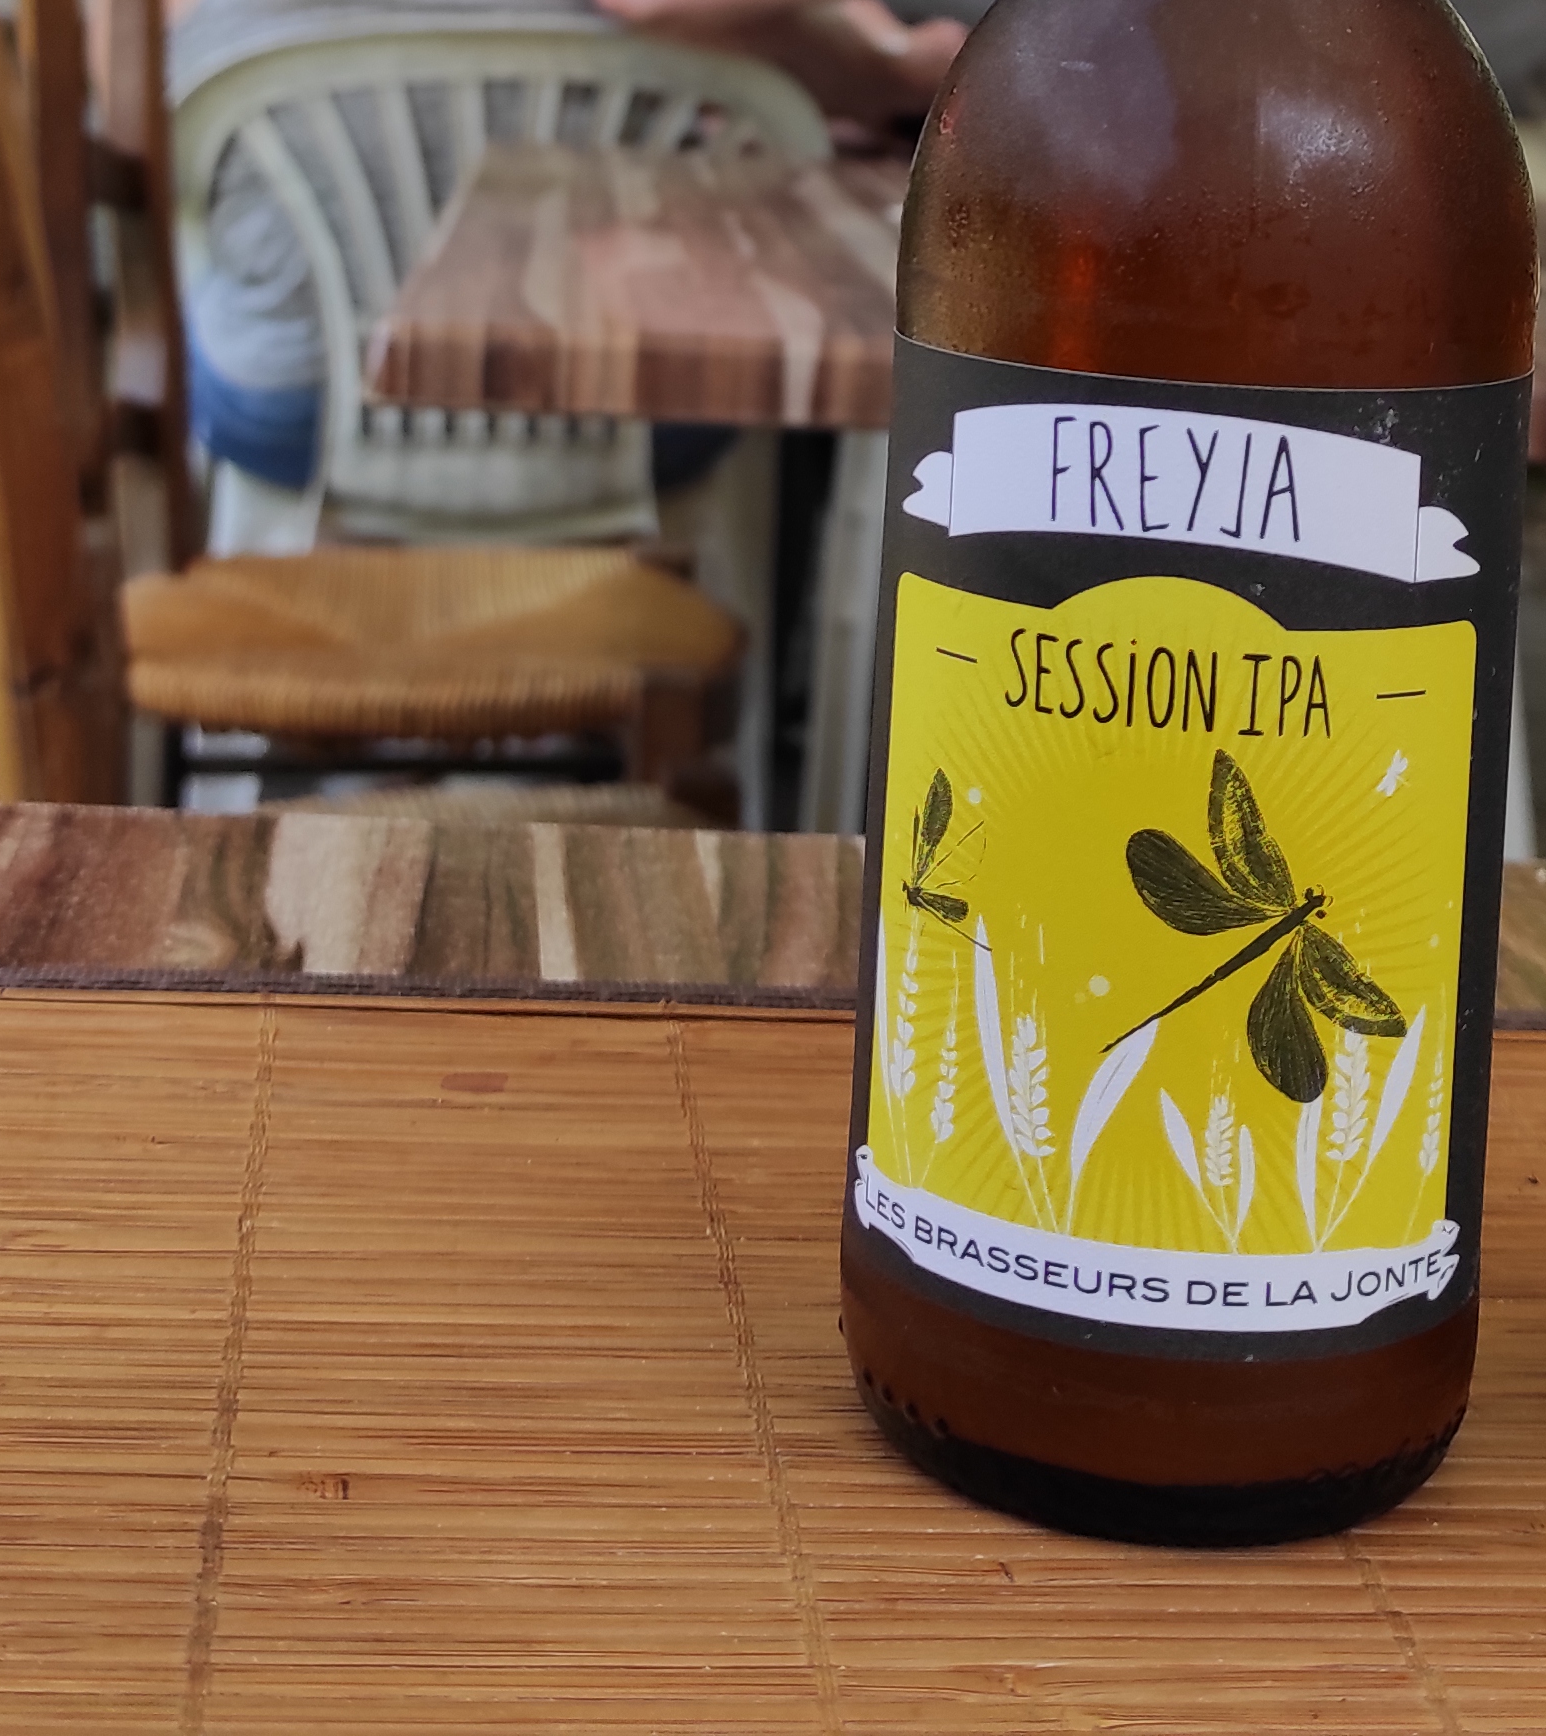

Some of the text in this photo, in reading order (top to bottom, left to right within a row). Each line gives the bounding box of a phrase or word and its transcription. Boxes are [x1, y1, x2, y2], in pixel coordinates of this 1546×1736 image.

[1050, 416, 1301, 542] FREYJA
[1238, 652, 1331, 738] IPA
[865, 1174, 1442, 1307] LES BRASSEURS DE LA JONTE
